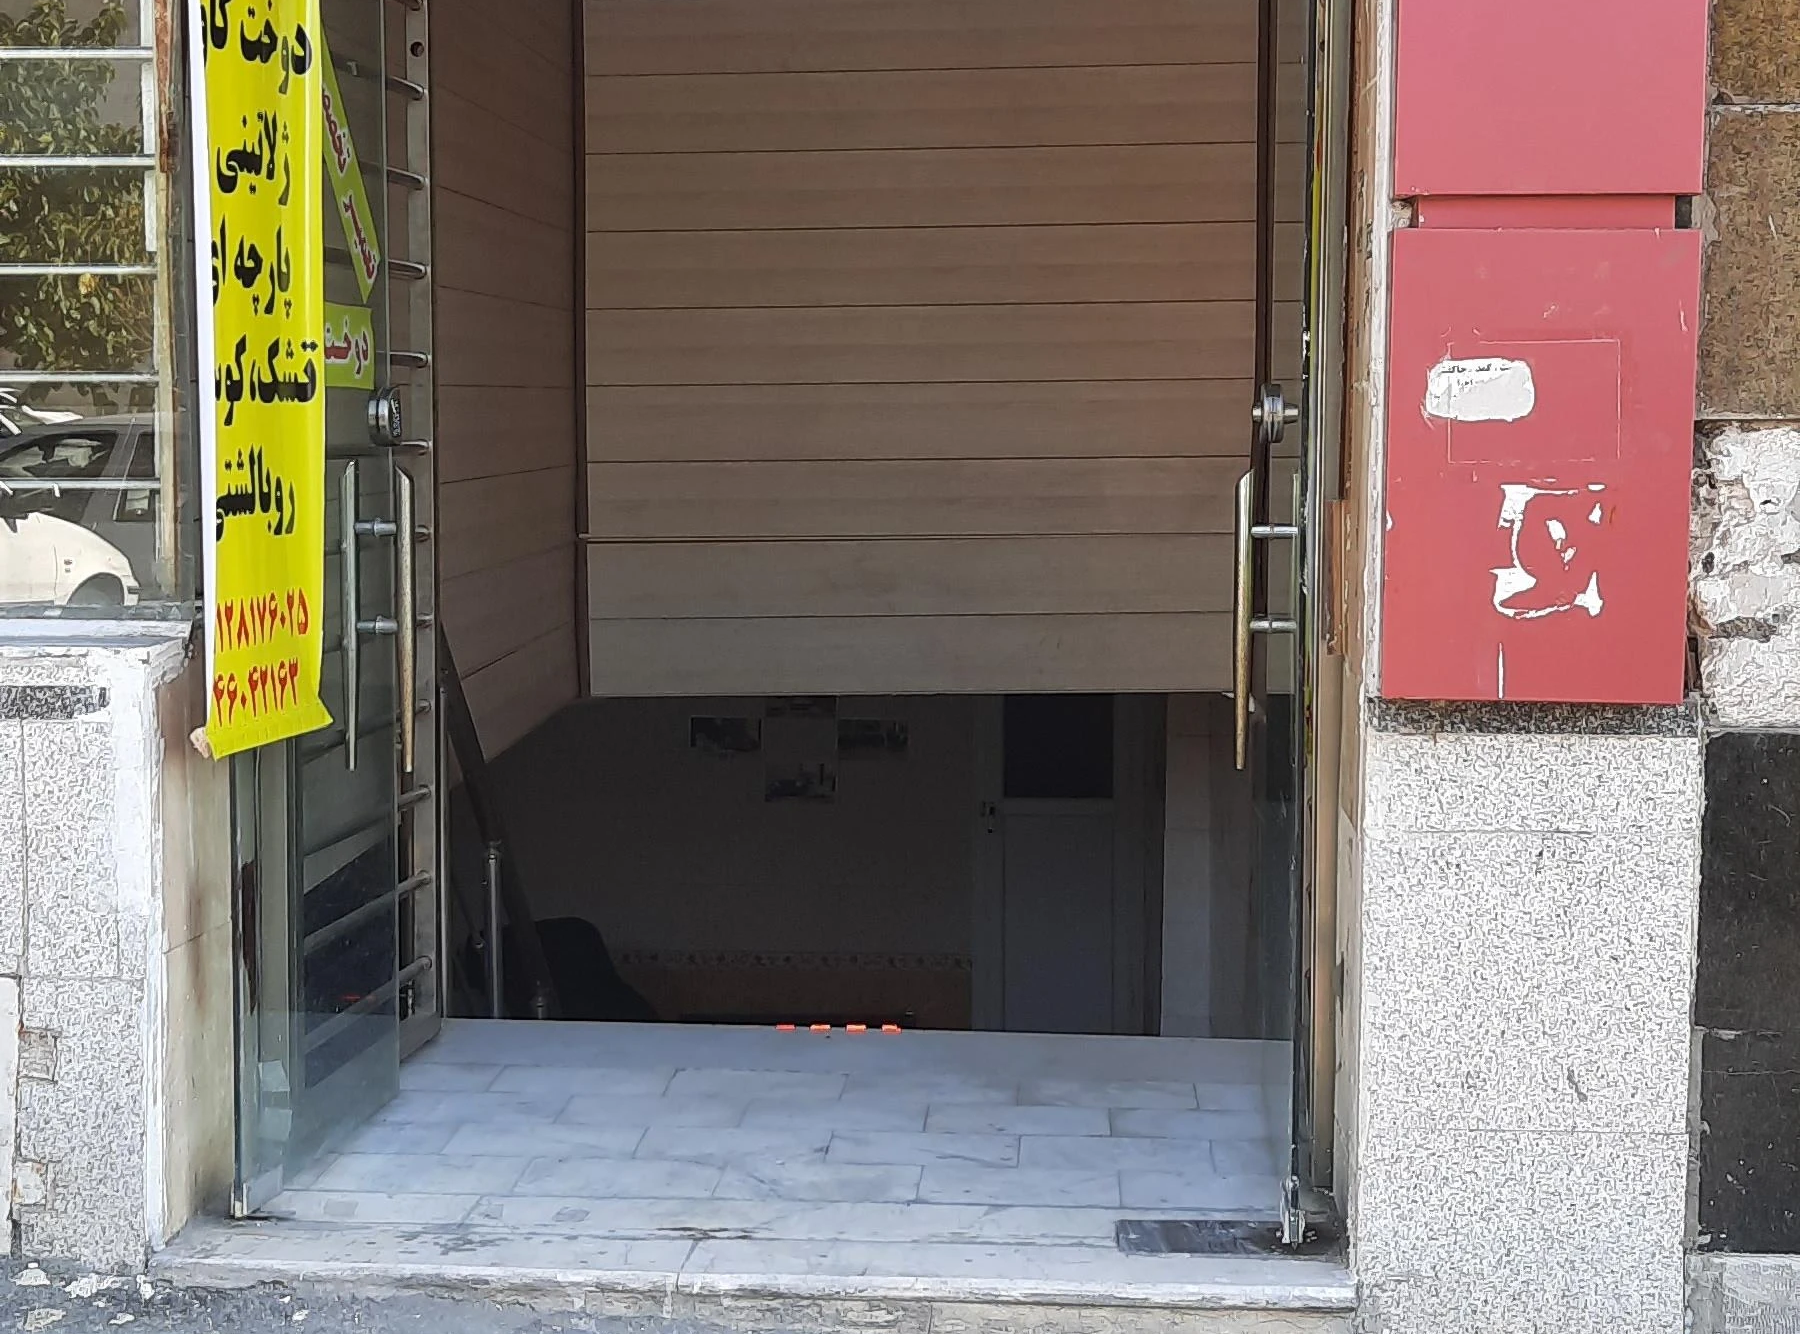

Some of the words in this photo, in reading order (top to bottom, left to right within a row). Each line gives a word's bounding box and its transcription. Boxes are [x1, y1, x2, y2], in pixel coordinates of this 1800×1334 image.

[216, 109, 291, 207] ژلاتینی
[233, 224, 292, 320] پارچه
[214, 332, 248, 427] کو
[216, 442, 296, 543] روبالشتی
[216, 586, 309, 654] ۱۲۸۱۷۶۰۲۵
[212, 656, 299, 728] ۴۶۰۴۲۱۶۳
